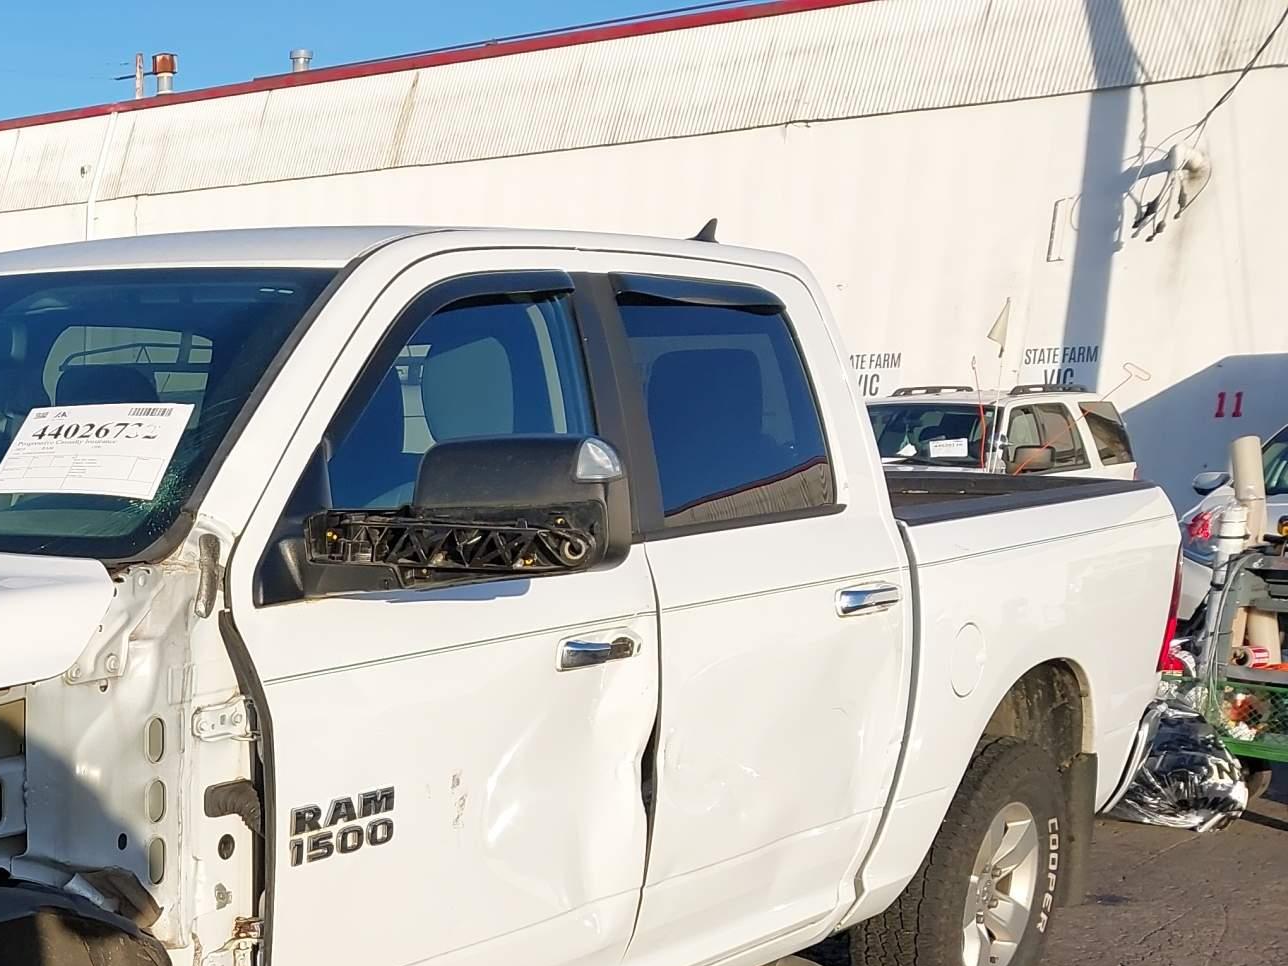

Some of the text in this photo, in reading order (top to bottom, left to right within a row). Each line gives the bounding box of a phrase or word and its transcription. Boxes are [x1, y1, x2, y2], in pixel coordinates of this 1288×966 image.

[869, 352, 902, 369] FARM
[1024, 345, 1099, 365] STATE FARM
[1044, 368, 1074, 384] VIC
[1215, 392, 1243, 417] 11
[290, 786, 395, 836] RAM
[289, 817, 395, 868] 1500
[1036, 817, 1059, 934] COOPER
